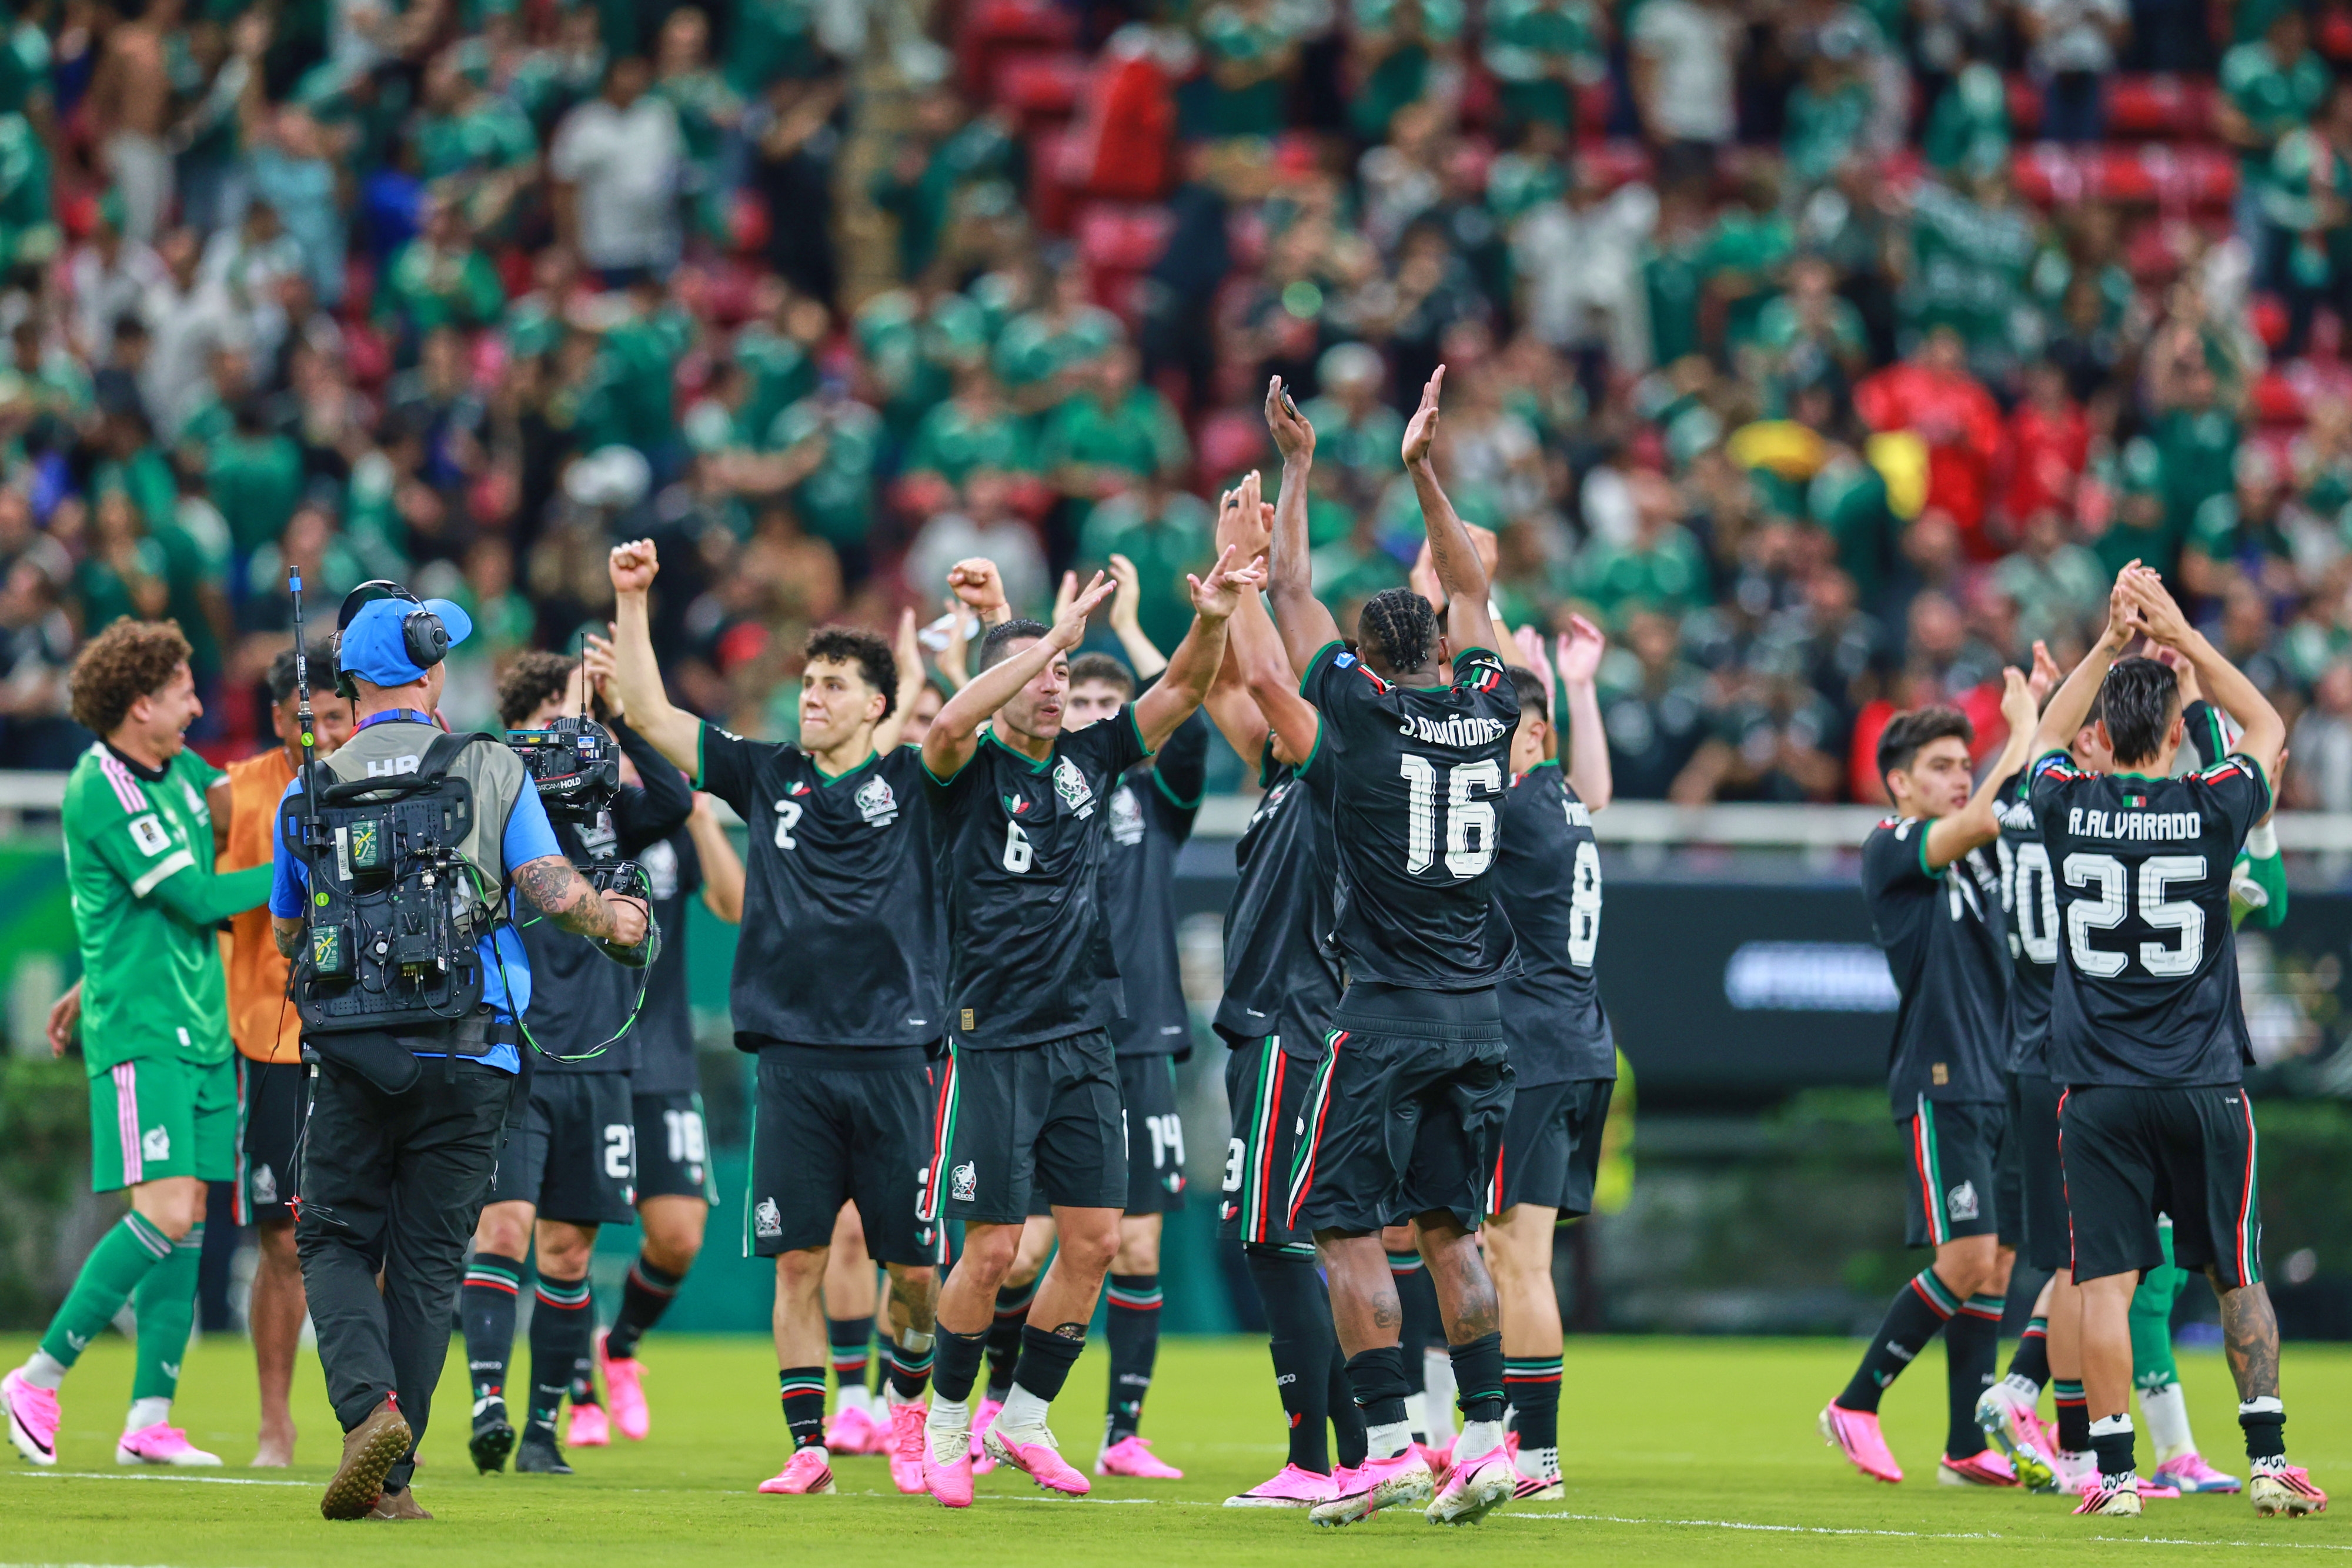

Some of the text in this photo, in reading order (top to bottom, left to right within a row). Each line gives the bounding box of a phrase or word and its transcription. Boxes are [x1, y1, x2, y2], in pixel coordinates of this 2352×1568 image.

[1399, 713, 1506, 747] J.QUIÑONES
[560, 777, 581, 789] HOLD
[774, 799, 803, 850] 2
[1400, 753, 1502, 878] 16
[2068, 807, 2201, 841] R.ALVARADO
[1003, 819, 1033, 874] 6
[1568, 840, 1602, 968] 8
[2063, 852, 2207, 978] 25
[1145, 1113, 1185, 1169] 14
